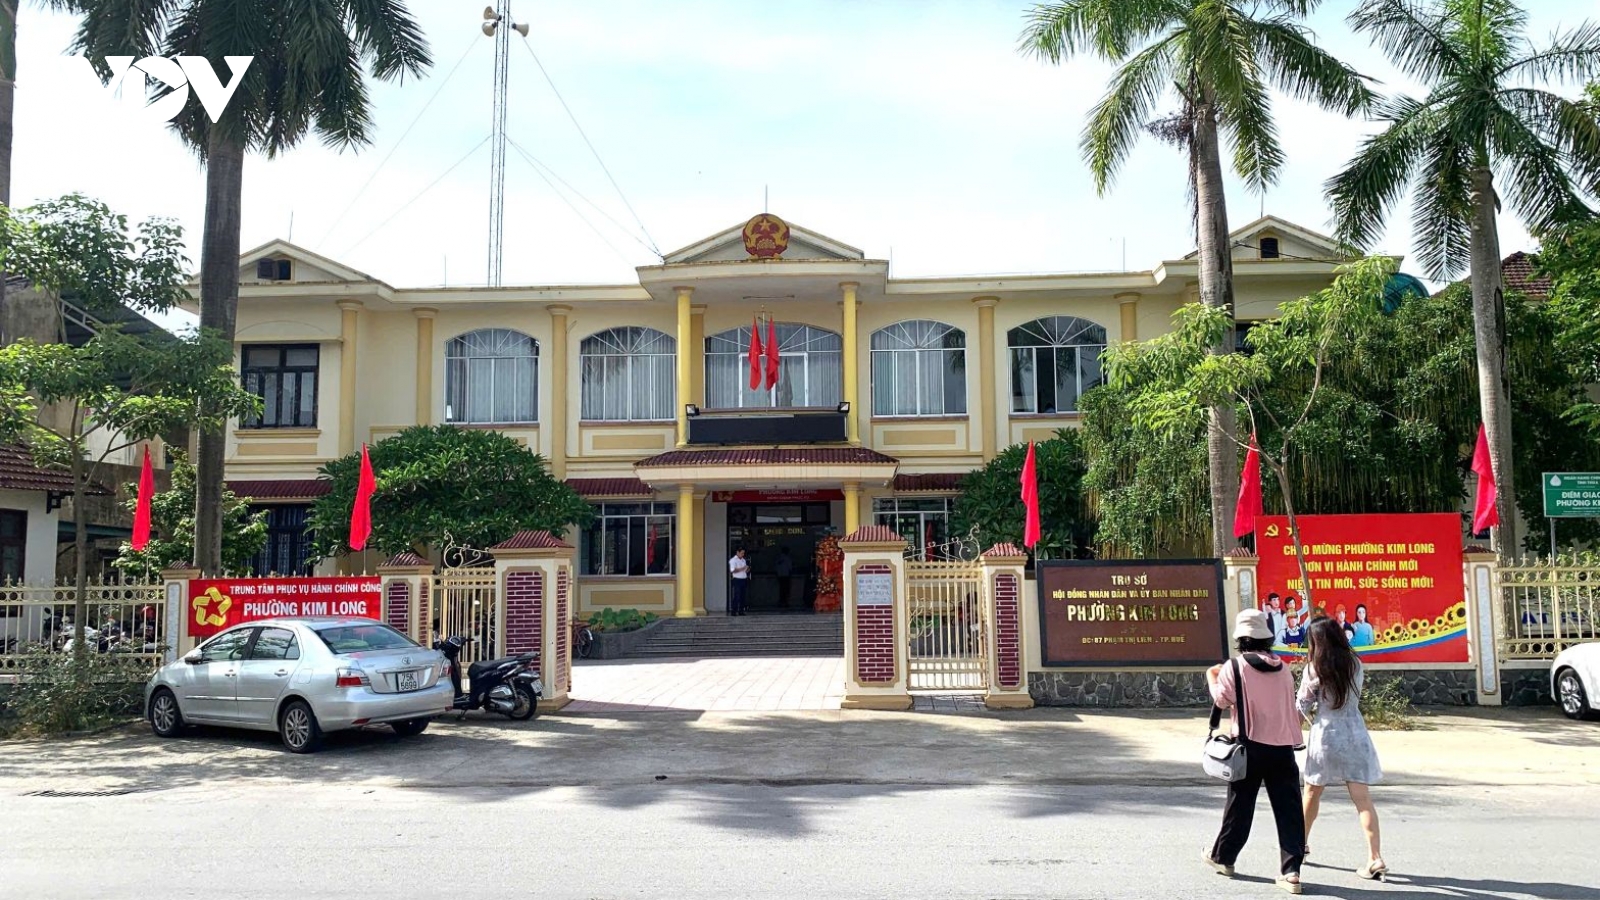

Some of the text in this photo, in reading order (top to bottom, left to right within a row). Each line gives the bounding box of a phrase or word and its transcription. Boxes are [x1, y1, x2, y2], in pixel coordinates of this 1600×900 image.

[1283, 541, 1435, 556] CHO MỪNG PHƯỜNG KIM LONG
[1324, 561, 1334, 575] VỊ
[1336, 559, 1363, 572] HÀNH
[1366, 559, 1397, 572] CHÍNH
[1399, 559, 1418, 571] MỚI
[230, 581, 381, 596] TRUNG TÂM PHỤC VỤ HÀNH CHÍNH CÔNG
[1111, 574, 1131, 588] TRỤ
[1315, 578, 1331, 589] TIN
[1334, 577, 1357, 591] MỚI,
[1358, 576, 1379, 589] SỨC
[1381, 573, 1408, 589] SỐNG
[1411, 576, 1434, 589] MỚI!
[1053, 589, 1065, 601] HỘI
[1067, 587, 1087, 599] ĐỒNG
[1089, 588, 1109, 599] NHÂN
[1111, 588, 1127, 598] DÂN
[1129, 588, 1139, 598] VÀ
[1140, 587, 1150, 598] ỦY
[1152, 590, 1168, 598] BAN
[243, 599, 367, 617] PHƯỜNG KIM LONG
[1067, 600, 1199, 621] PHƯỜNG KIM LONG
